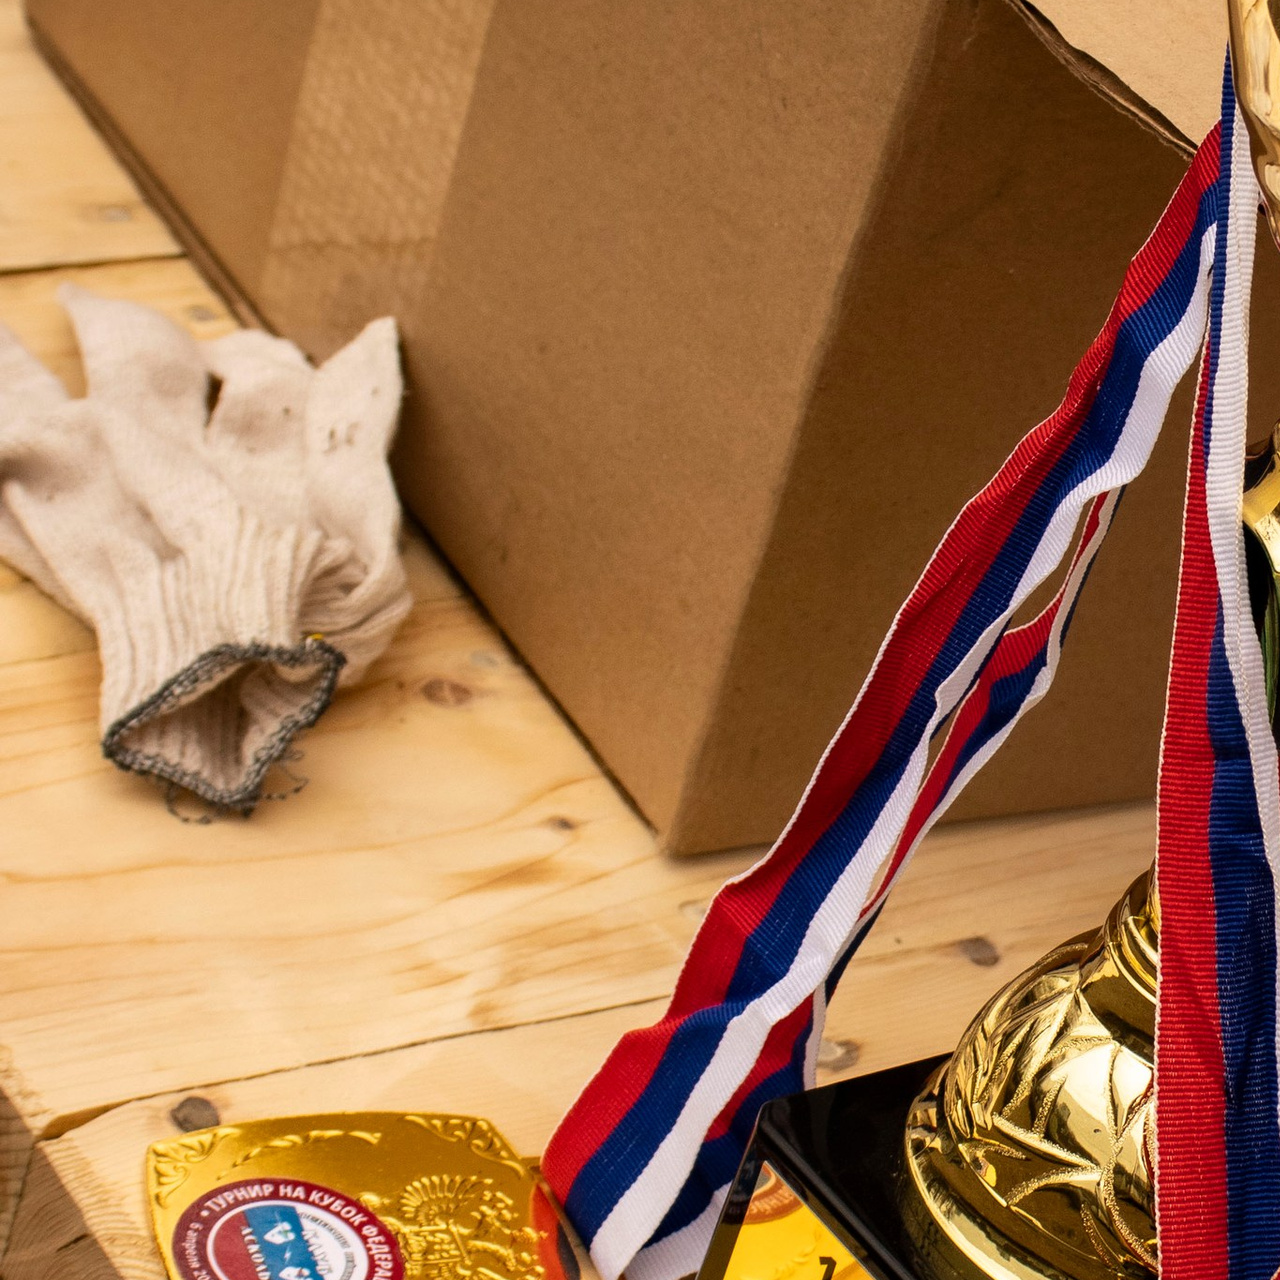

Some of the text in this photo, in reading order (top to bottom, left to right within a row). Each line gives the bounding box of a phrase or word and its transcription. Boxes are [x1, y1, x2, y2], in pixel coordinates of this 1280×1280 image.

[204, 1184, 274, 1212] ТУРНИР
[279, 1184, 306, 1200] НА
[309, 1189, 368, 1226] КУБОК
